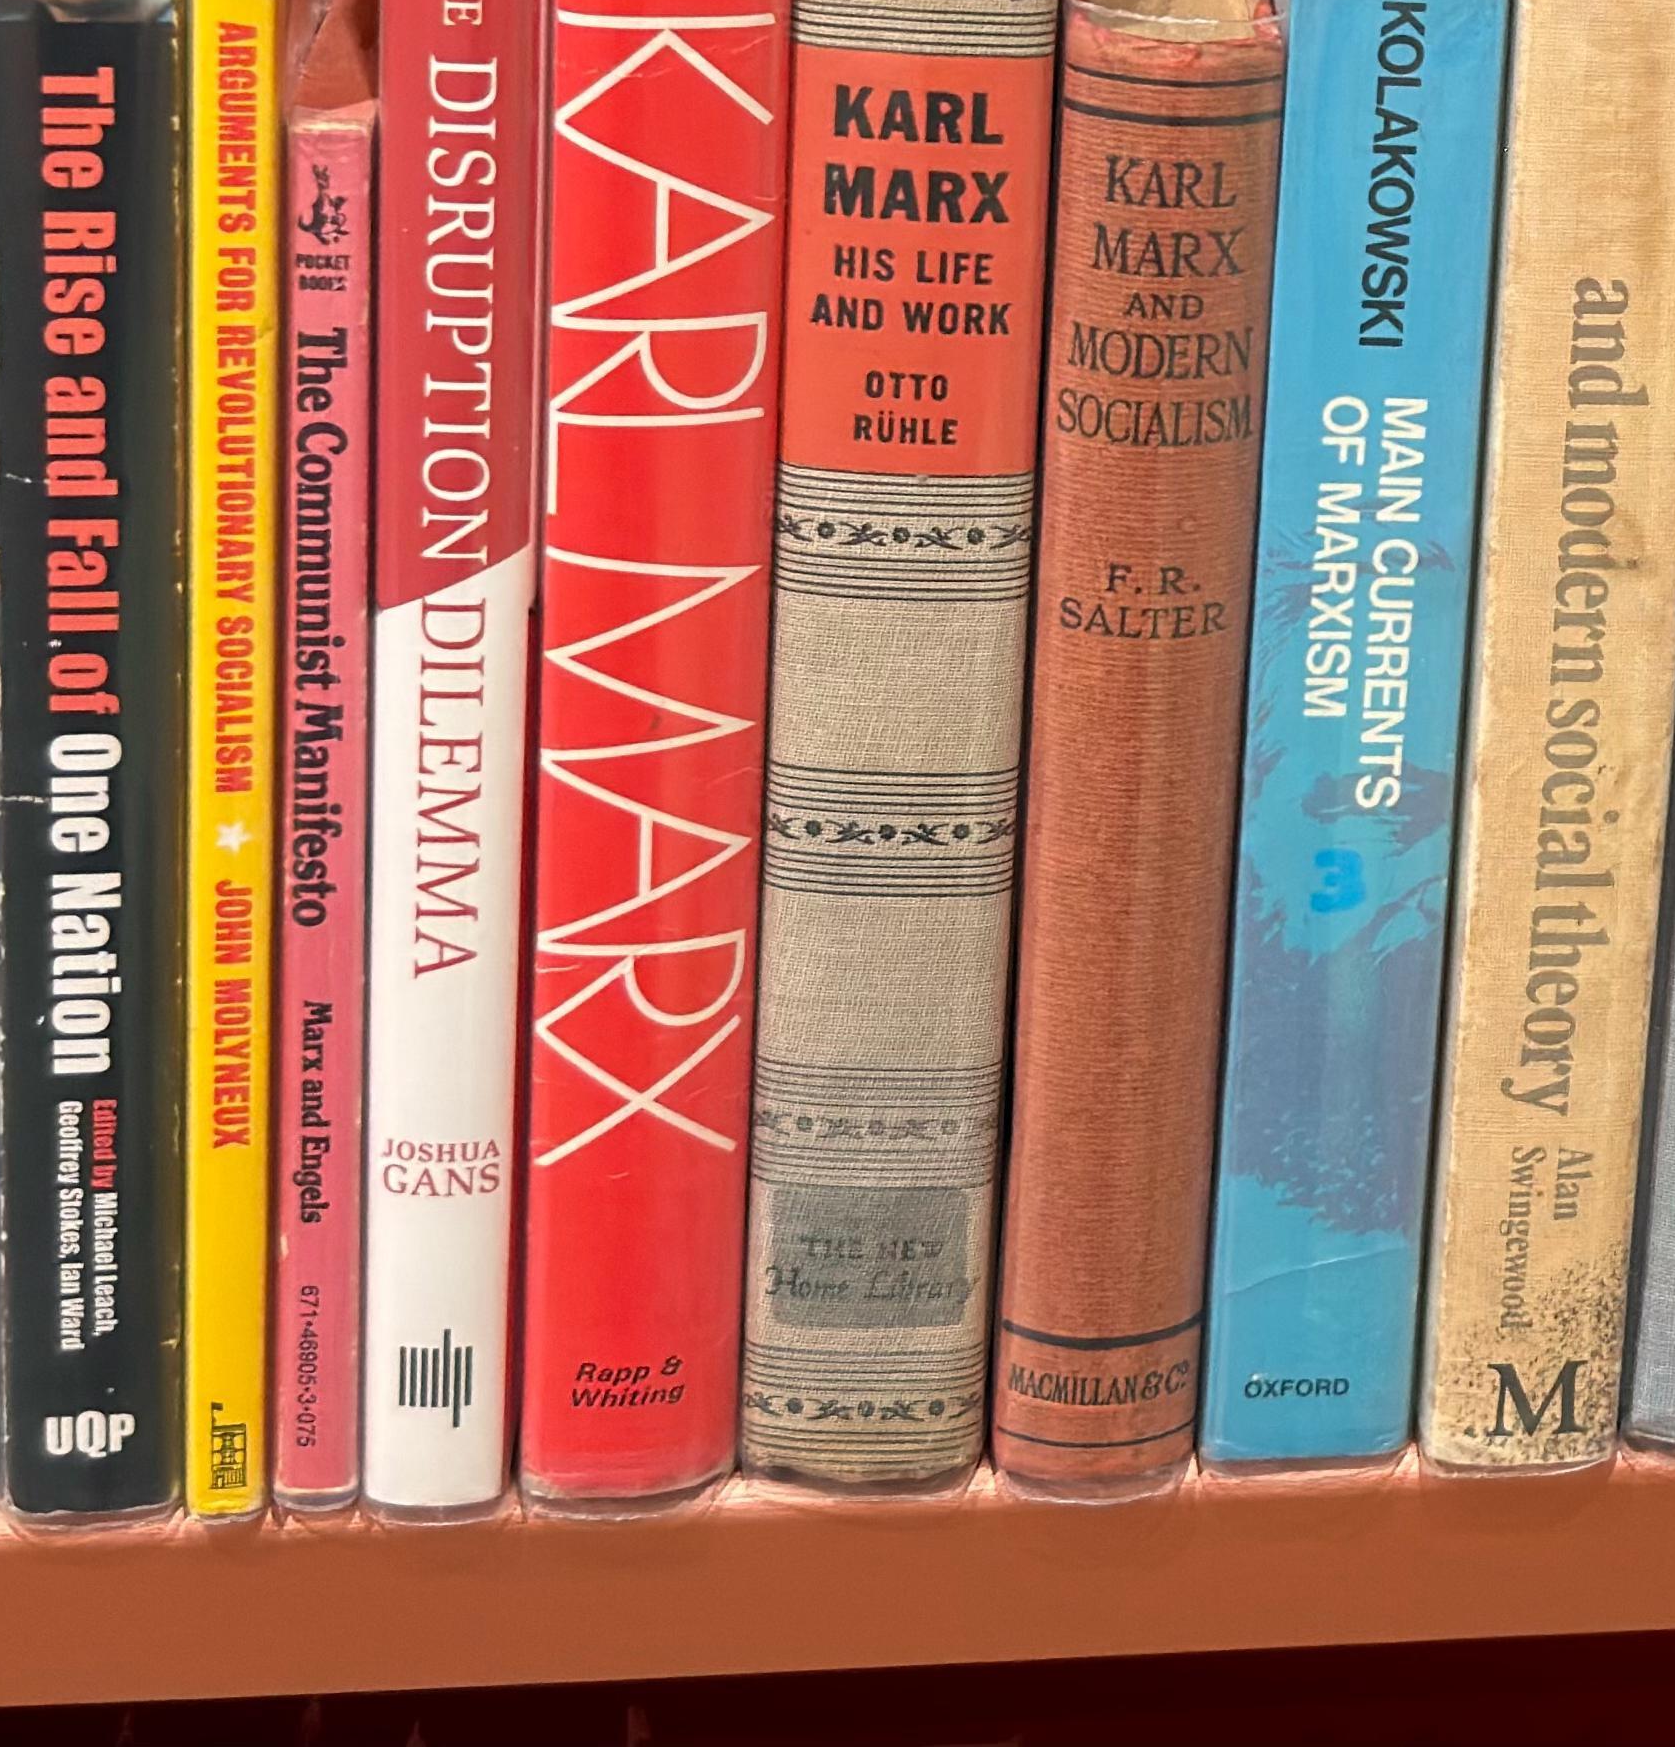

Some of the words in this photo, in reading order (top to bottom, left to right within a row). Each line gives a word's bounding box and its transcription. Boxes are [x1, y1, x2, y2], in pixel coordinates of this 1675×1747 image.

[41, 66, 116, 190] The
[216, 21, 258, 235] ARGUMENTS
[832, 84, 1004, 146] KARL
[823, 164, 1011, 224] MARX
[1104, 155, 1238, 211] KARL
[1357, 0, 1427, 349] KOLAKOWSKI
[41, 210, 118, 355] Rise
[216, 245, 258, 313] FOR
[545, 10, 777, 516] KARL
[833, 246, 895, 284] HIS
[917, 248, 994, 286] LIFE
[1093, 223, 1245, 278] MARX
[421, 54, 498, 566] DISRUPTION
[810, 294, 892, 332] AND
[903, 301, 1011, 336] WORK
[1123, 292, 1206, 320] AND
[1568, 276, 1650, 410] and
[863, 370, 949, 403] OTTO
[1066, 321, 1254, 380] MODERN
[44, 376, 120, 498] and
[853, 410, 959, 447] RÜHLE
[1056, 387, 1254, 448] SOCIALISM
[1321, 395, 1369, 466] OF
[216, 324, 258, 603] REVOLUTIONARY
[1372, 396, 1428, 524] MAIN
[45, 518, 120, 632] Fall
[1104, 563, 1144, 595] F.
[1160, 566, 1201, 596] R.
[1549, 420, 1640, 693] modern
[1060, 596, 1228, 638] SALTER
[1302, 480, 1363, 719] MARXISM
[48, 648, 122, 715] of
[214, 614, 256, 794] SOCIALISM
[1353, 543, 1420, 809] CURRENTS
[48, 733, 123, 854] One
[413, 595, 487, 981] DILEMMA
[1535, 703, 1618, 891] social
[535, 544, 762, 1167] MARX
[212, 880, 254, 965] JOHN
[50, 872, 123, 1077] Nation
[1503, 904, 1611, 1118] theory
[211, 975, 252, 1150] MOLYNEUX
[92, 1099, 117, 1160] Edited
[382, 1137, 502, 1165] JOSHUA
[91, 1165, 116, 1188] by
[382, 1164, 502, 1199] GANS
[1554, 1146, 1595, 1221] Alan
[93, 1192, 118, 1271] Michael
[570, 1381, 685, 1410] Whiting
[1244, 1377, 1350, 1399] OXFORD
[46, 1413, 136, 1457] UQP
